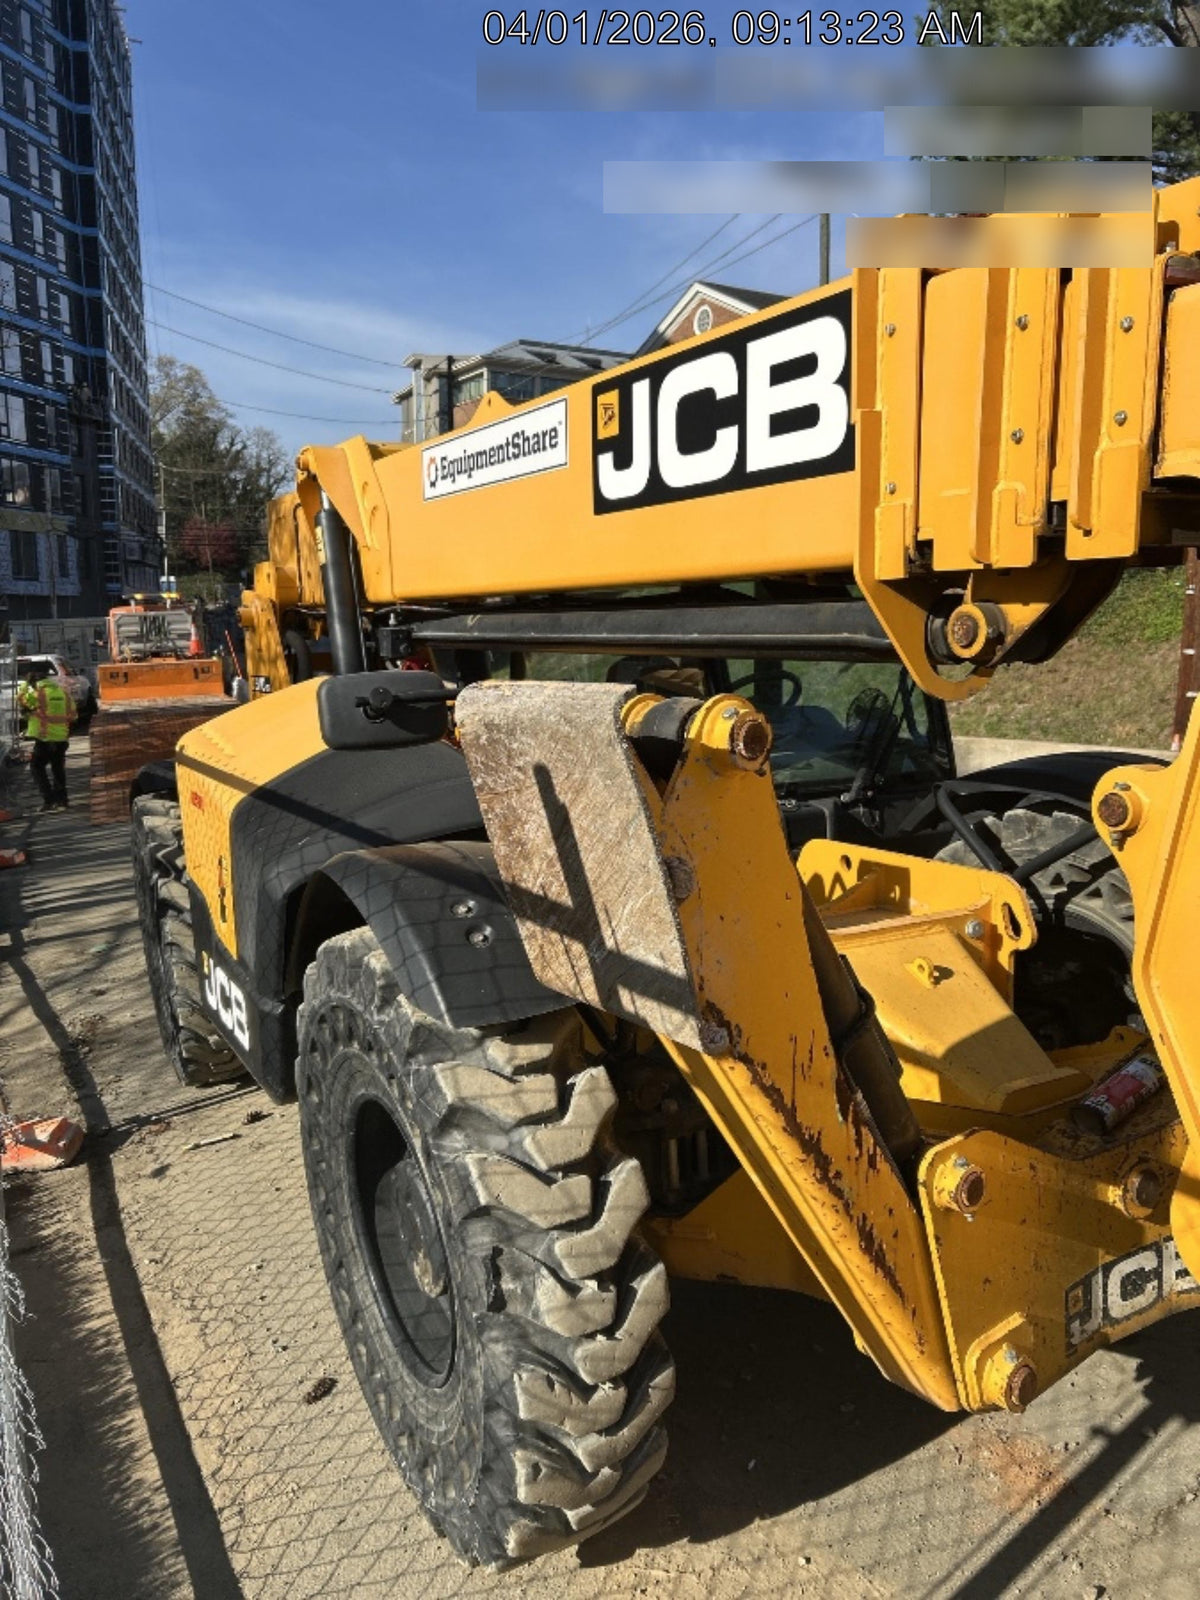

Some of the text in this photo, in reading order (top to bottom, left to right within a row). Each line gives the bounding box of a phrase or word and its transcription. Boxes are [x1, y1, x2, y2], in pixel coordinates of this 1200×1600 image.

[440, 427, 559, 484] EquipmentShare
[597, 315, 849, 501] JCB
[205, 957, 250, 1052] JCB
